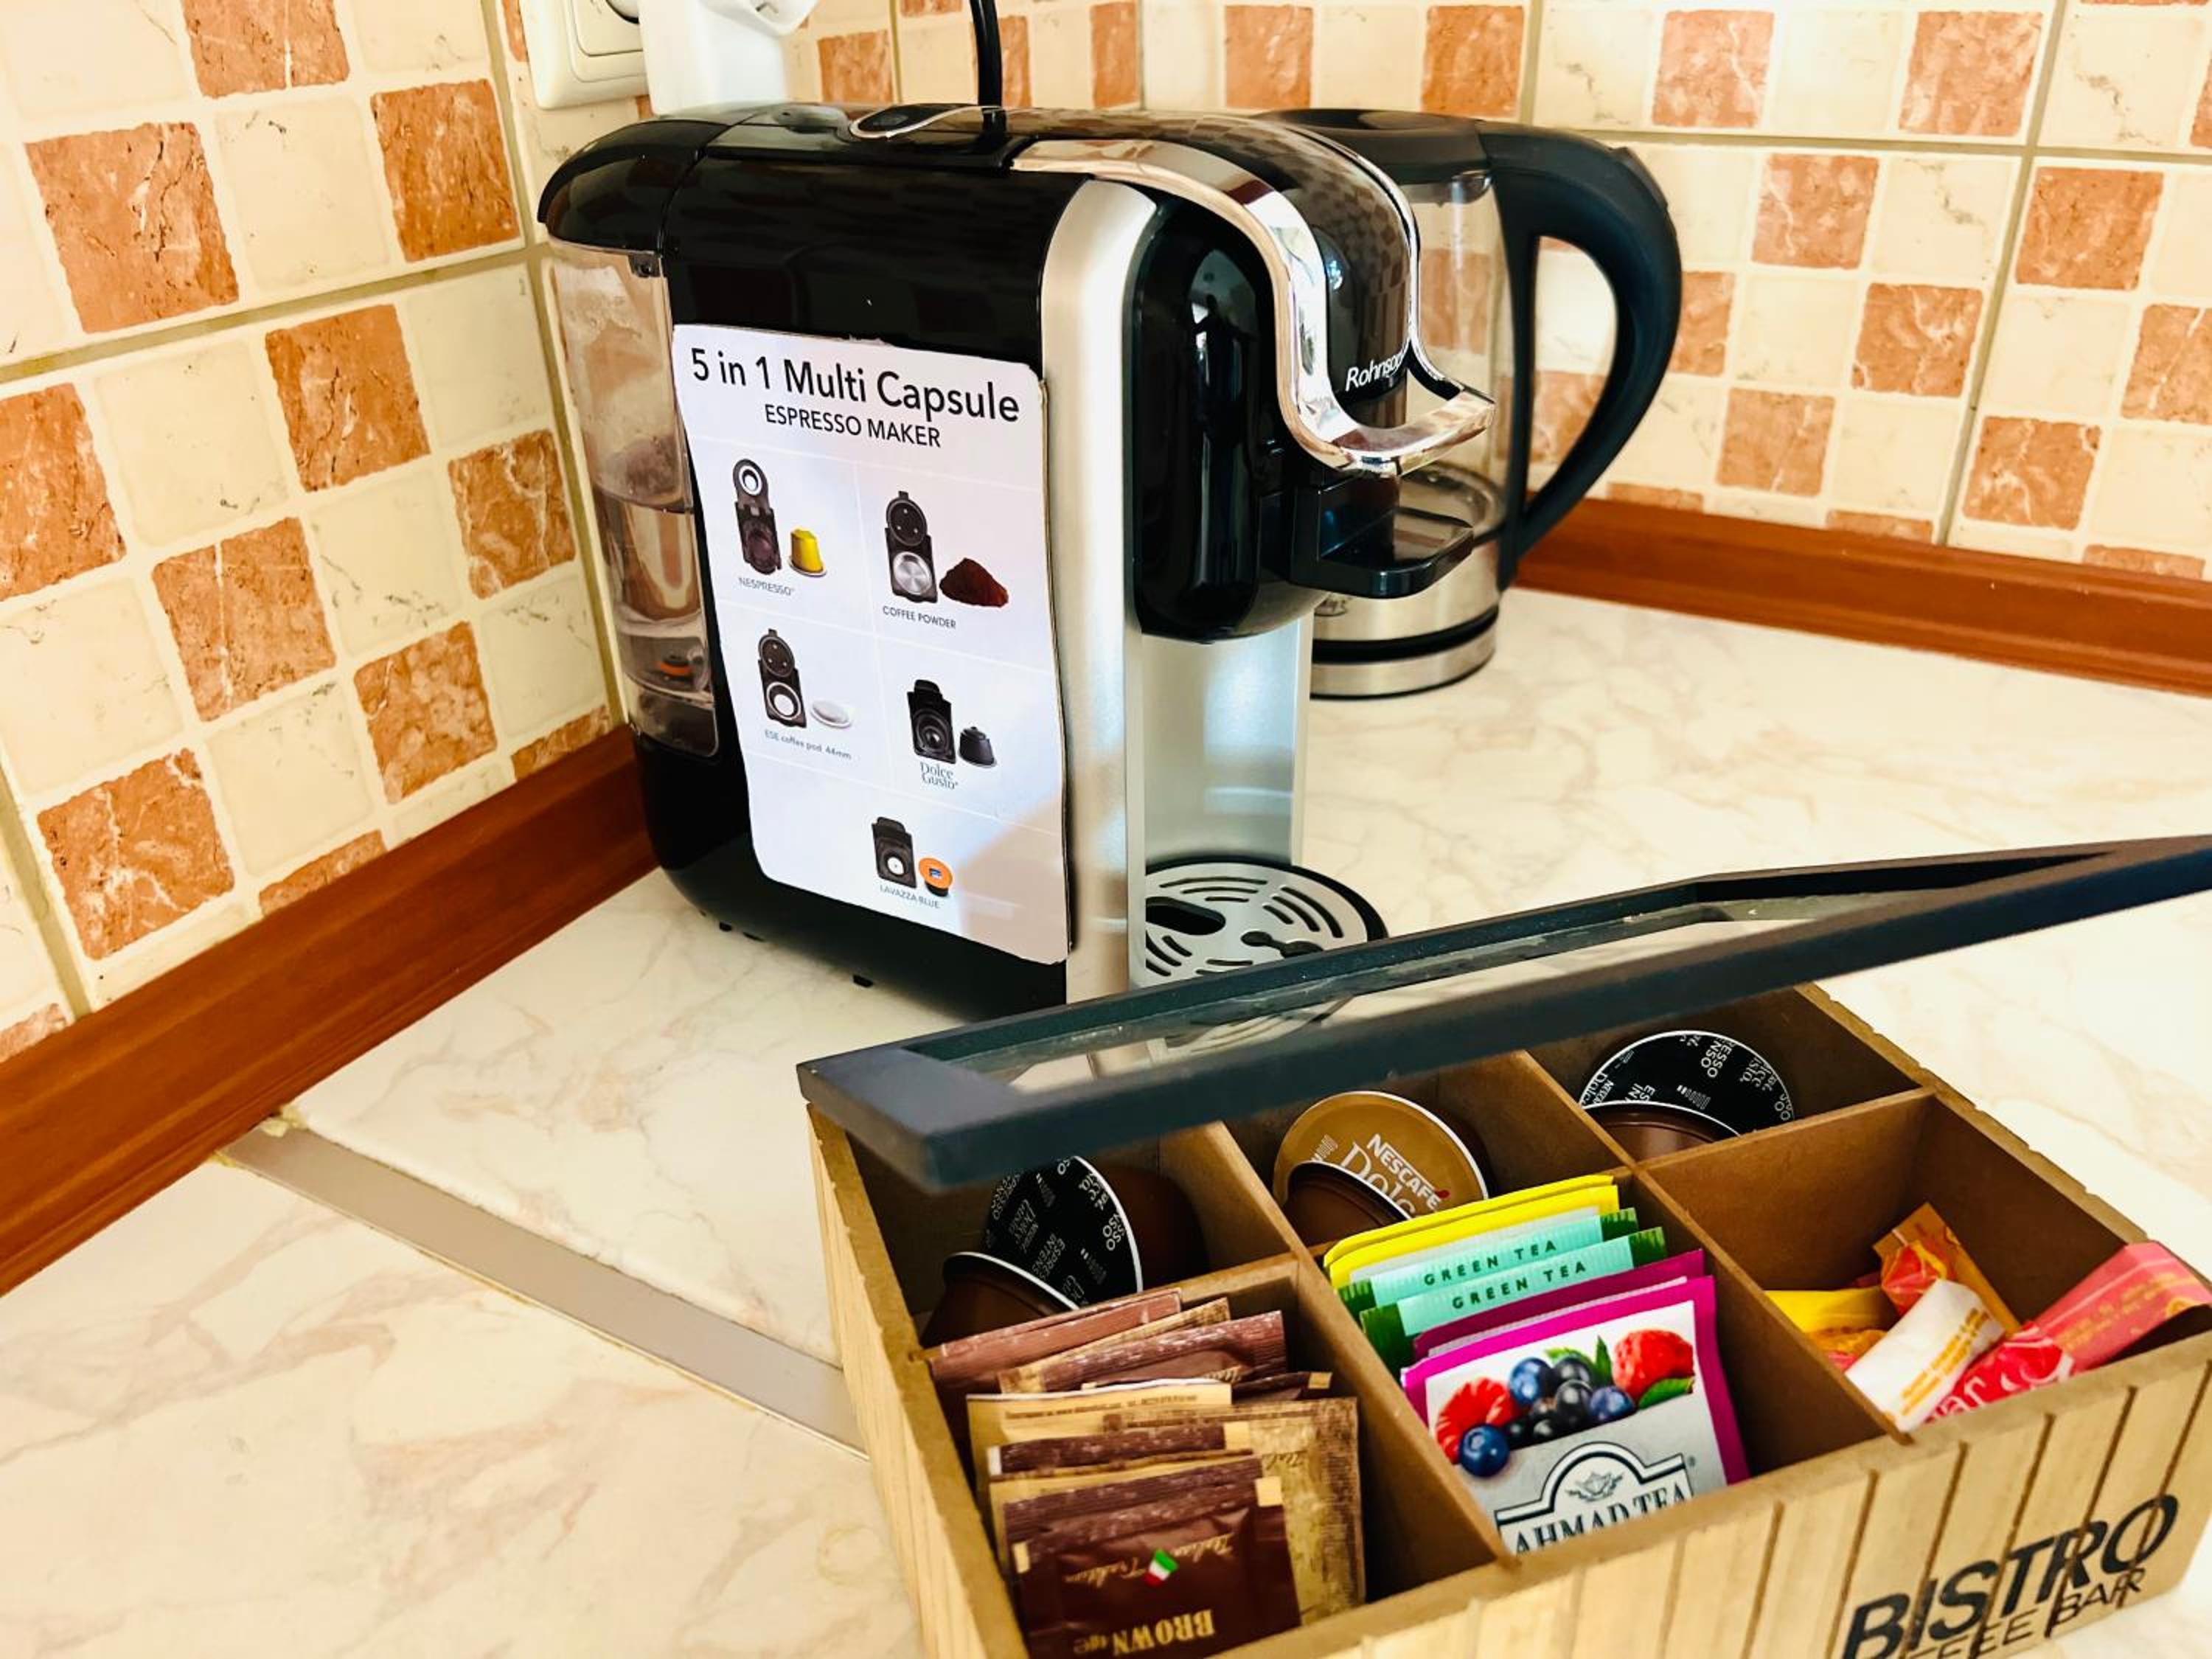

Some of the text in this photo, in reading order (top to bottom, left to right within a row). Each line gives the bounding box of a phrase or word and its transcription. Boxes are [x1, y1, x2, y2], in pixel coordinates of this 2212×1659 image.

[691, 347, 1020, 422] 5 in 1 Multi Capsule
[765, 405, 942, 448] ESPRESSO MAKER
[883, 605, 956, 629] COFFEE POWDER
[920, 762, 953, 779] Dolce
[880, 885, 941, 909] LAVAZZA BLUE
[1340, 1142, 1416, 1214] Dolc
[1424, 1240, 1557, 1286] GREEN TEA
[1453, 1261, 1587, 1310] GREEN TEA
[1516, 1483, 1686, 1555] AHMAD TEA
[1843, 1495, 2179, 1659] BISTRO
[2052, 1568, 2145, 1628] BAR
[1113, 1610, 1215, 1656] BROWN
